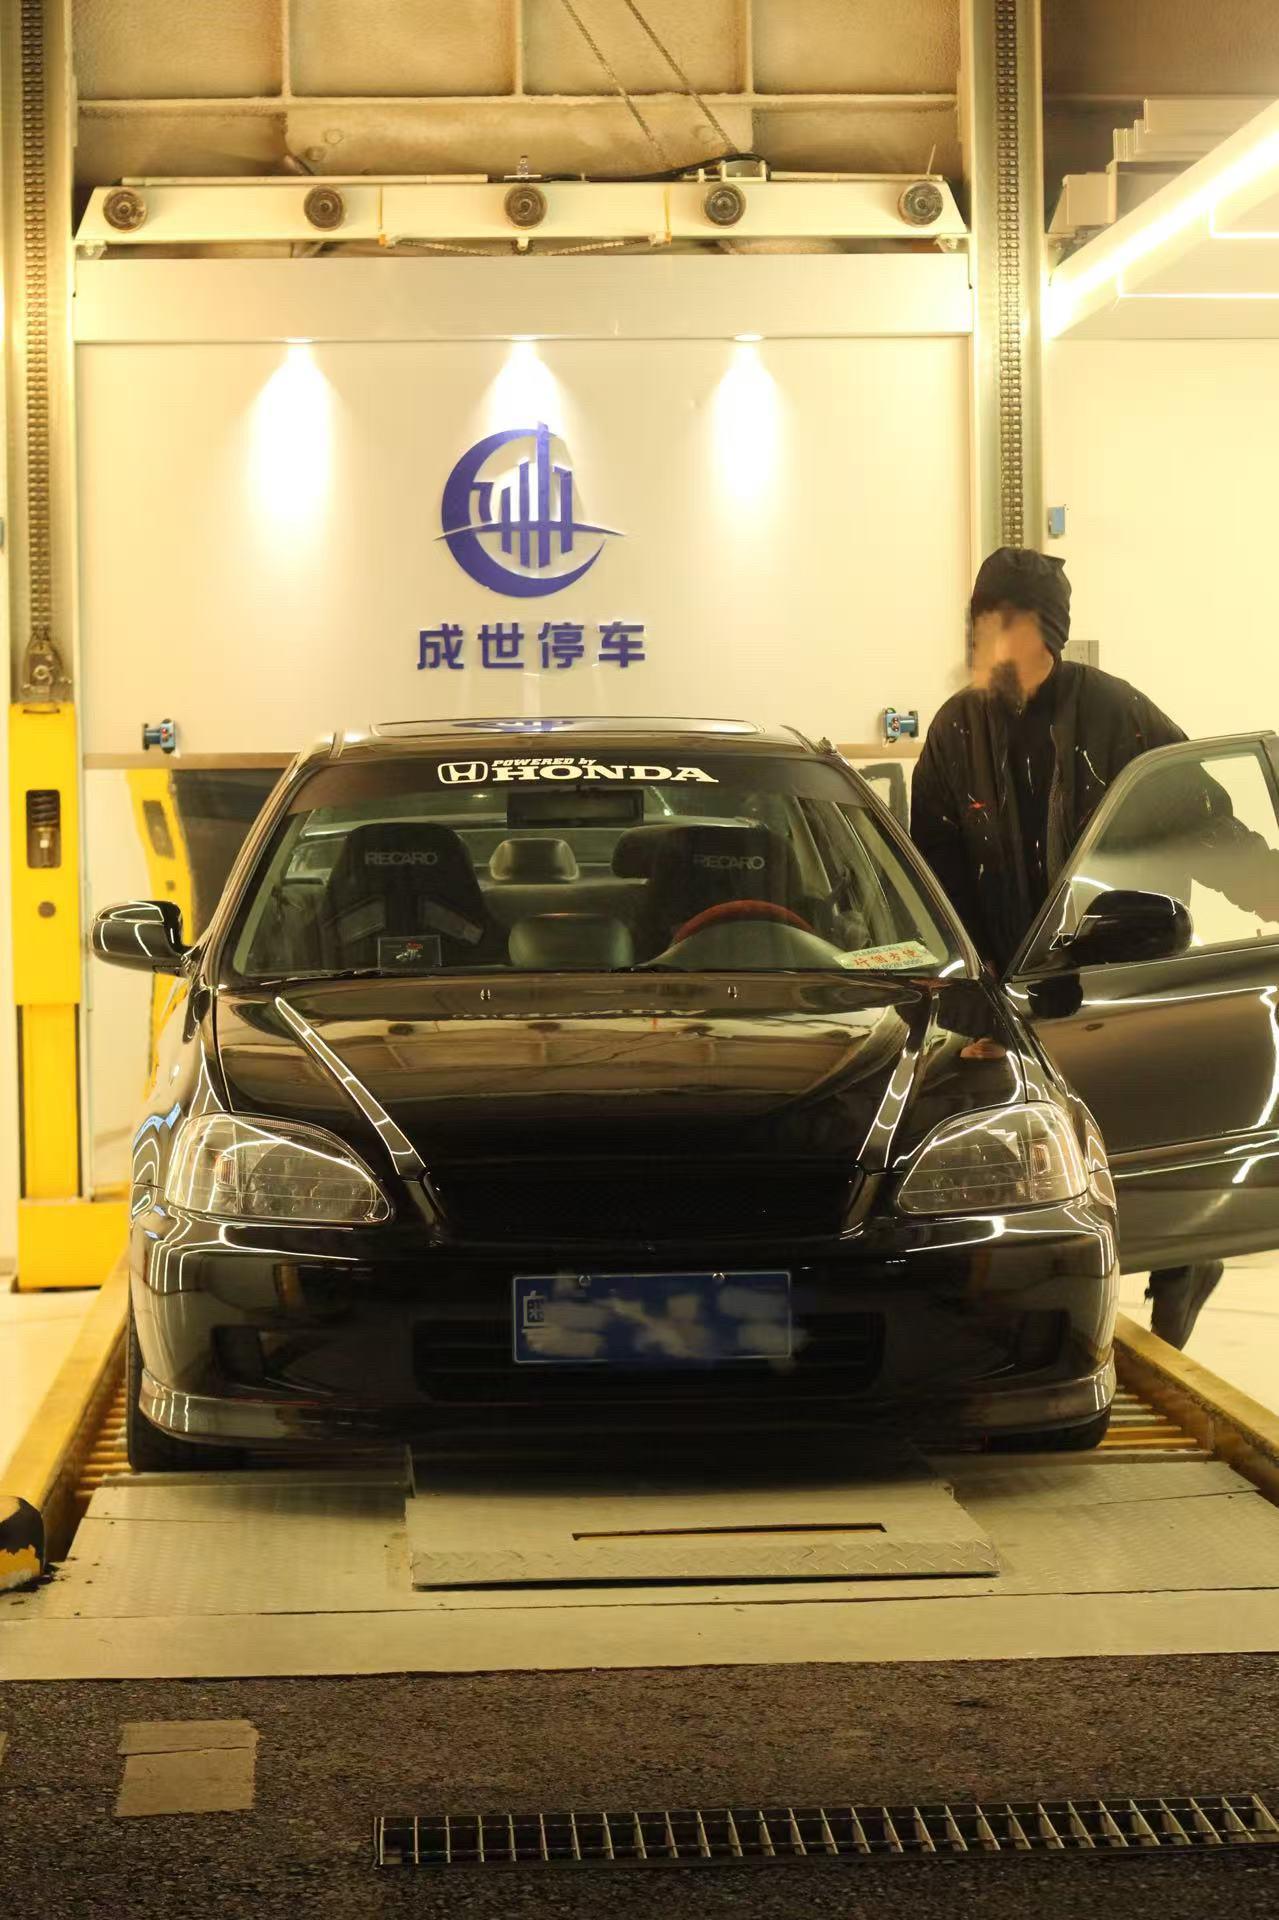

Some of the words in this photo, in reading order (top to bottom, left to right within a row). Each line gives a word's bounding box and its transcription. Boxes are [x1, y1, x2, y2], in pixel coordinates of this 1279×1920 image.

[417, 622, 645, 670] 成世停车
[491, 757, 575, 767] POWERED
[579, 758, 597, 766] by
[491, 765, 719, 782] HONDA
[364, 852, 438, 865] RECARO
